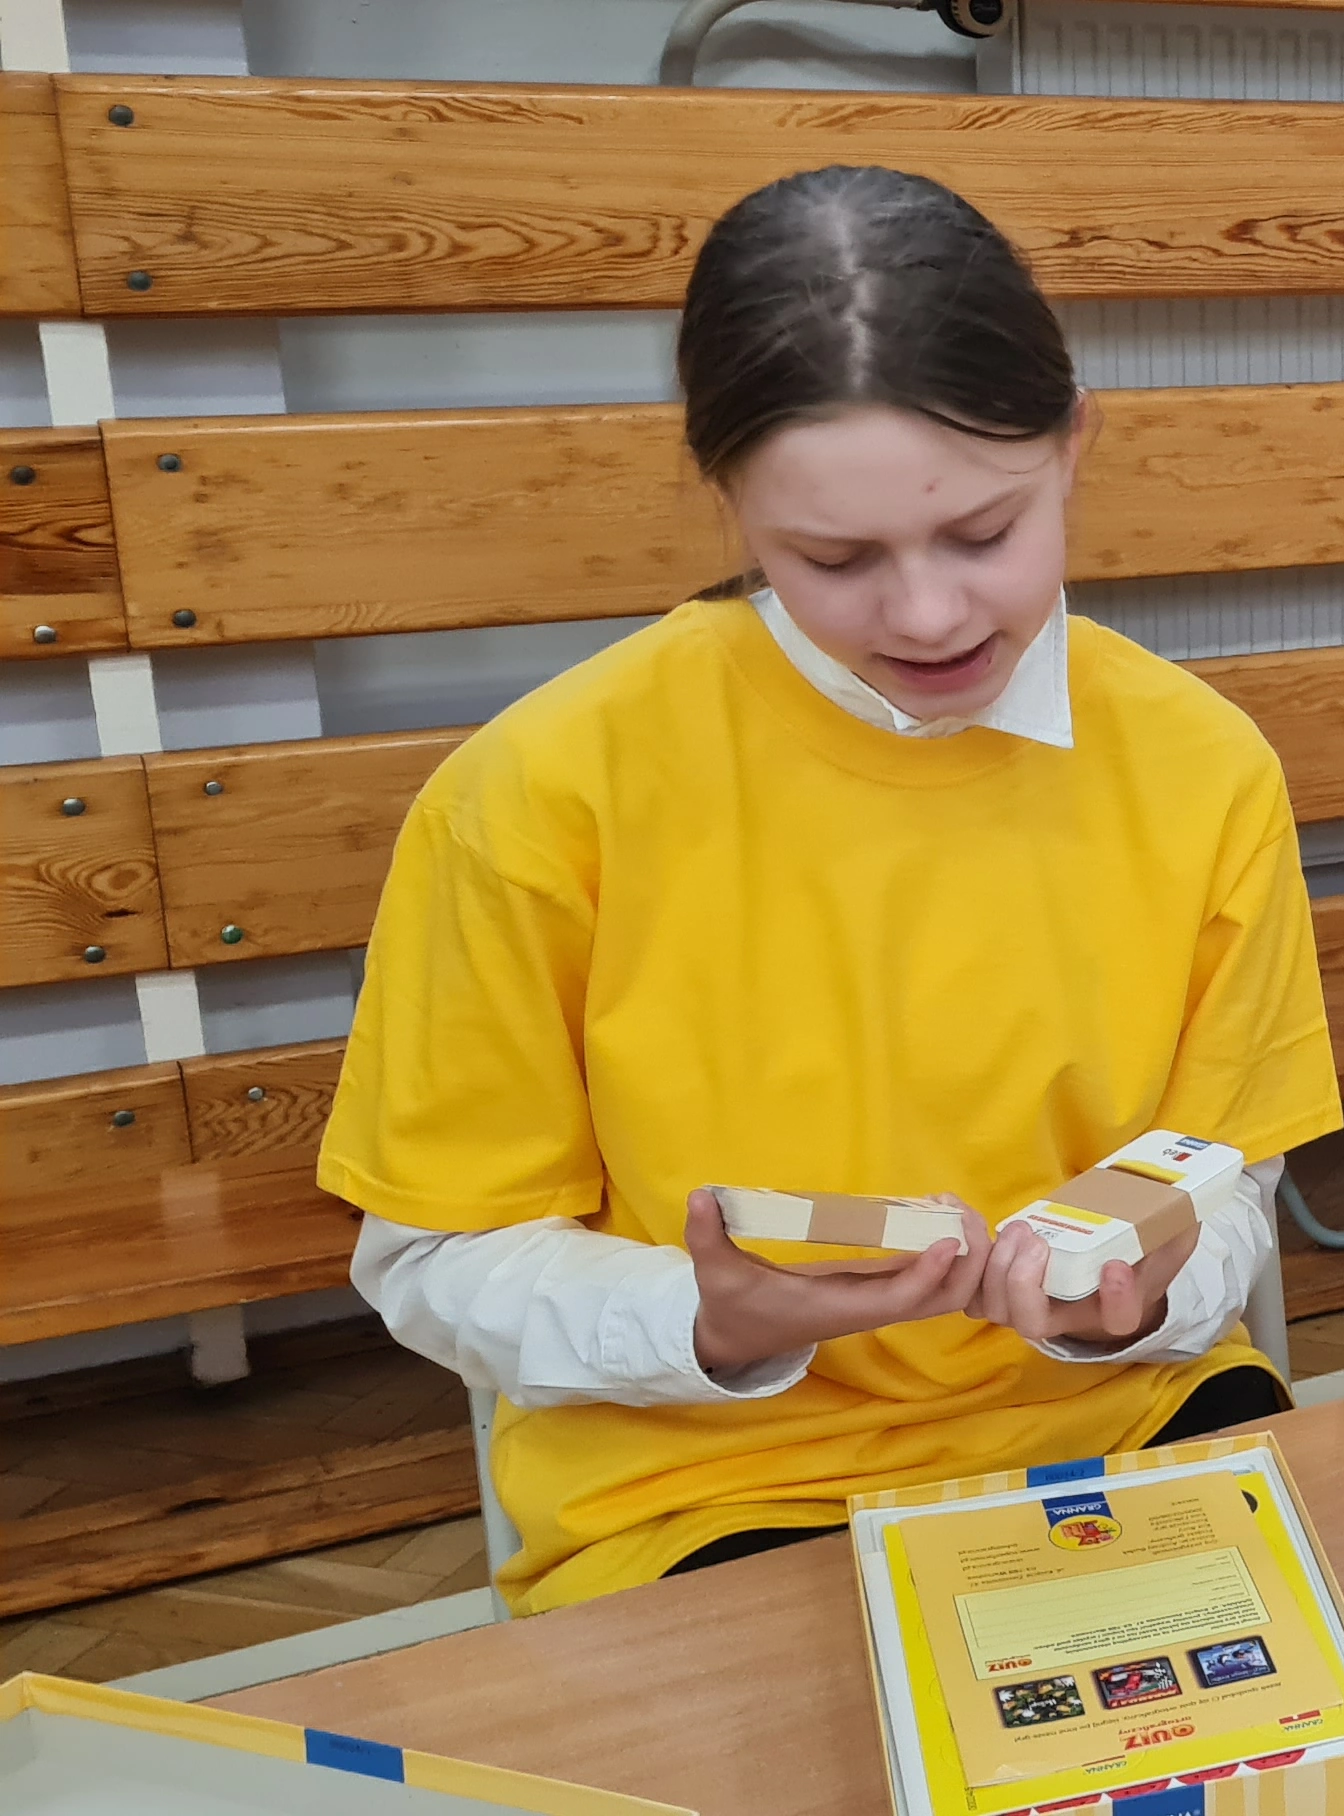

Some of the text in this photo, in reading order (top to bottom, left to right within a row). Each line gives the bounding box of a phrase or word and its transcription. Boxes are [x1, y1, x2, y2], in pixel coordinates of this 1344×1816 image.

[1053, 1503, 1102, 1516] GRANNA
[987, 1657, 1033, 1673] QUIZ
[1124, 1723, 1196, 1750] QUIZ
